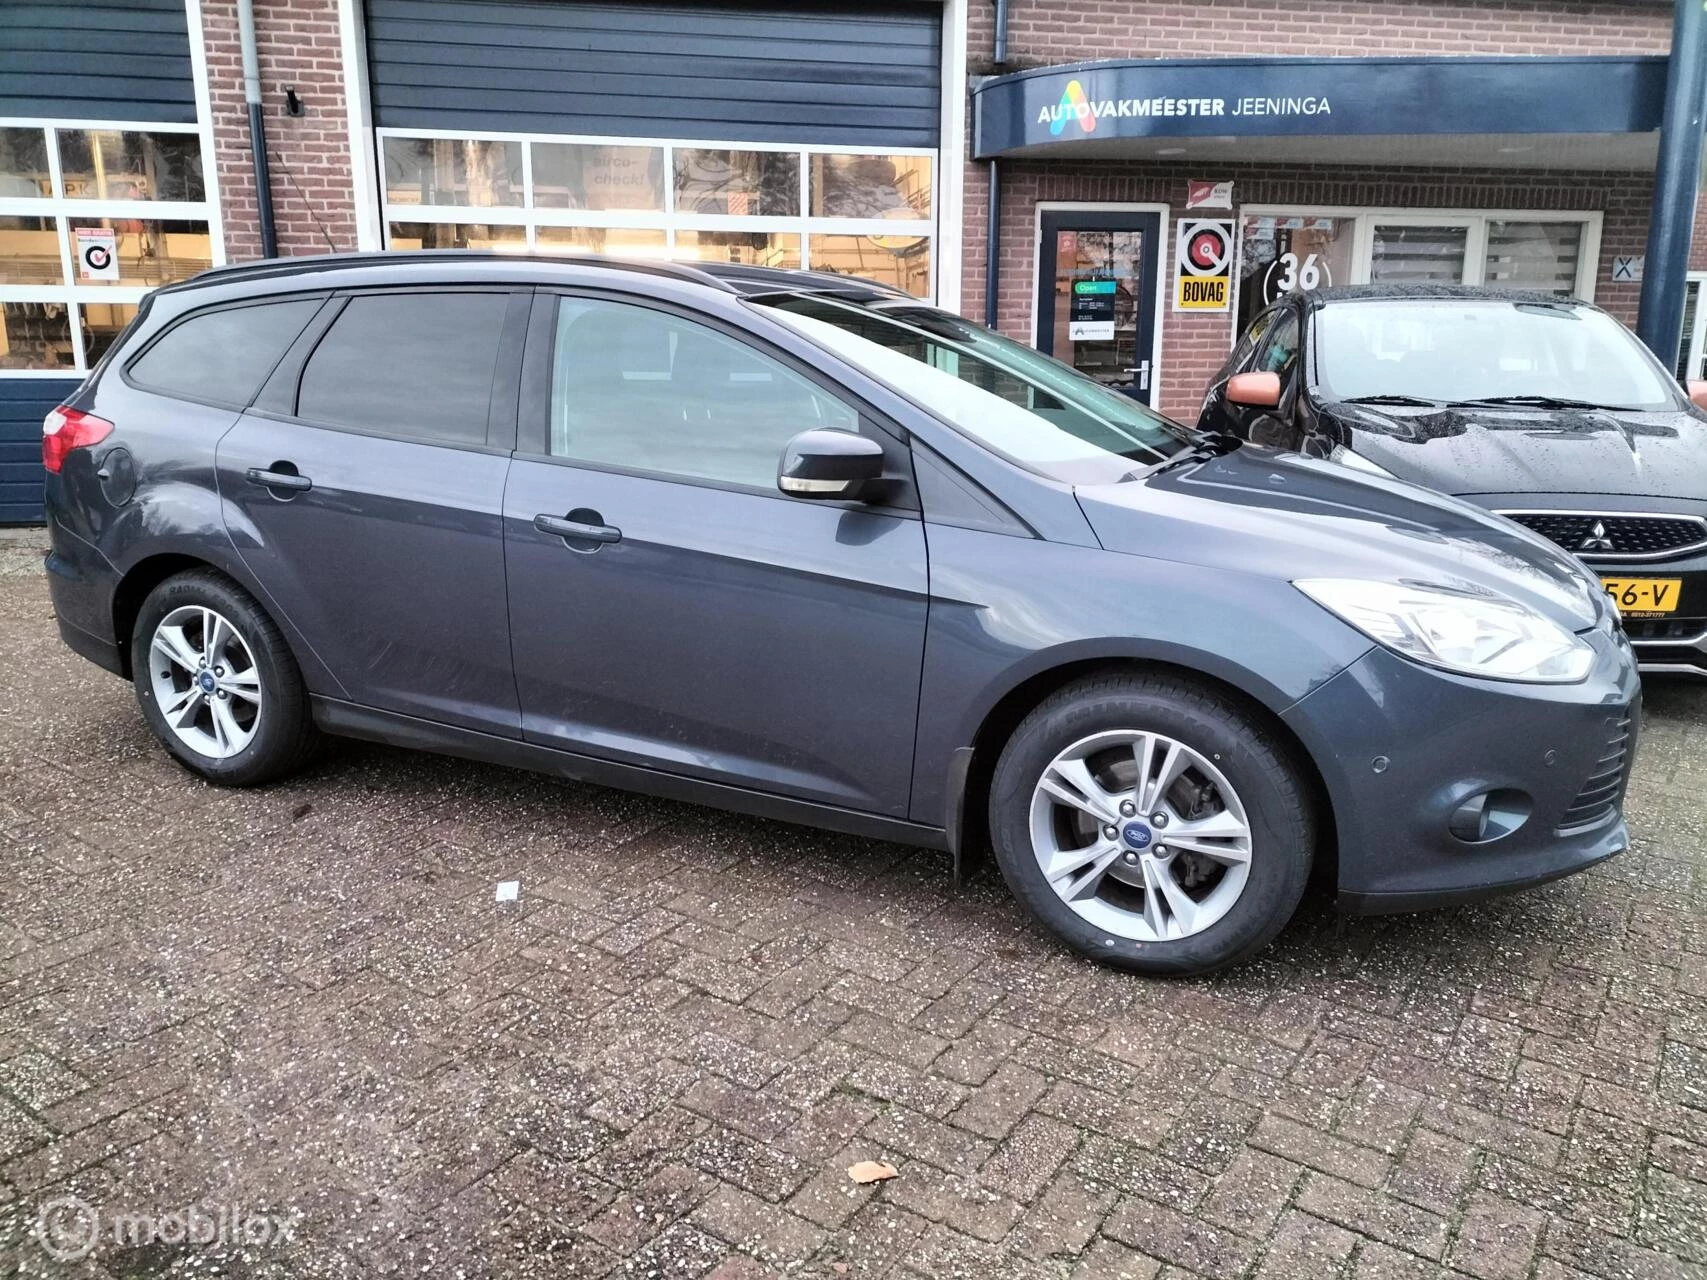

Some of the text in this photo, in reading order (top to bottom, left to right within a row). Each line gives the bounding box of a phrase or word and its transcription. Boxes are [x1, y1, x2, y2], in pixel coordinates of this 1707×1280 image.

[1037, 97, 1331, 124] AUTOVAKMEESTER JEENINGA
[1079, 284, 1097, 293] Open
[1183, 281, 1224, 302] BOVAG
